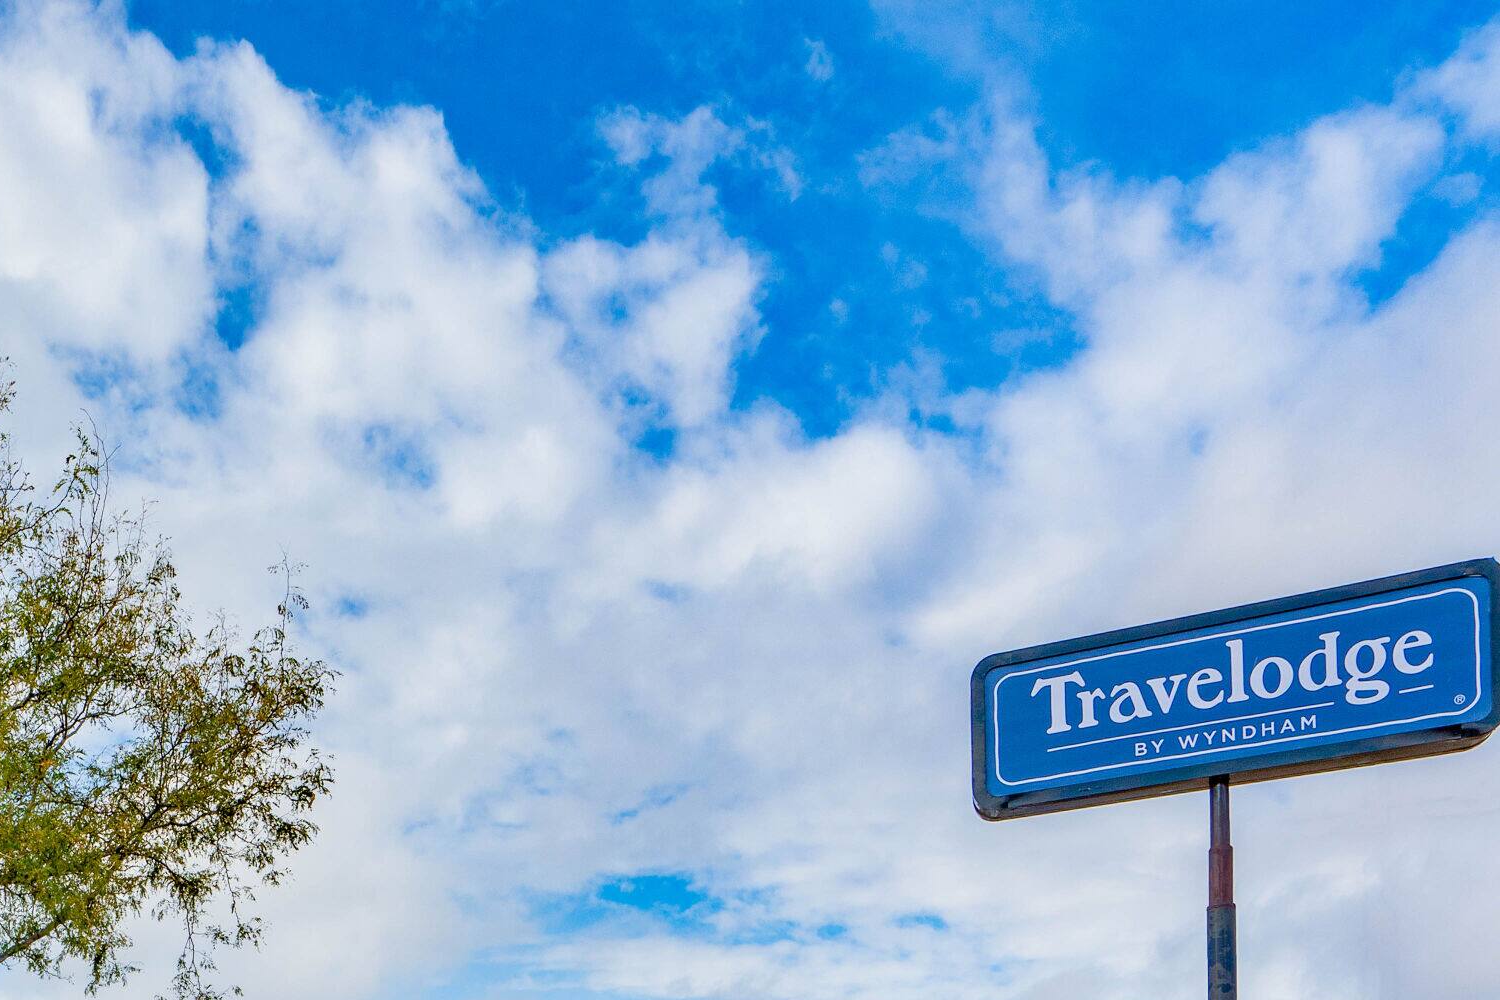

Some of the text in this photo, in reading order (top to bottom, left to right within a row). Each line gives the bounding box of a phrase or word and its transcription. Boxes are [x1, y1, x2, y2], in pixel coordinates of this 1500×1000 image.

[1031, 629, 1434, 735] Travelodge
[1133, 714, 1318, 757] BY WYNDHAM
